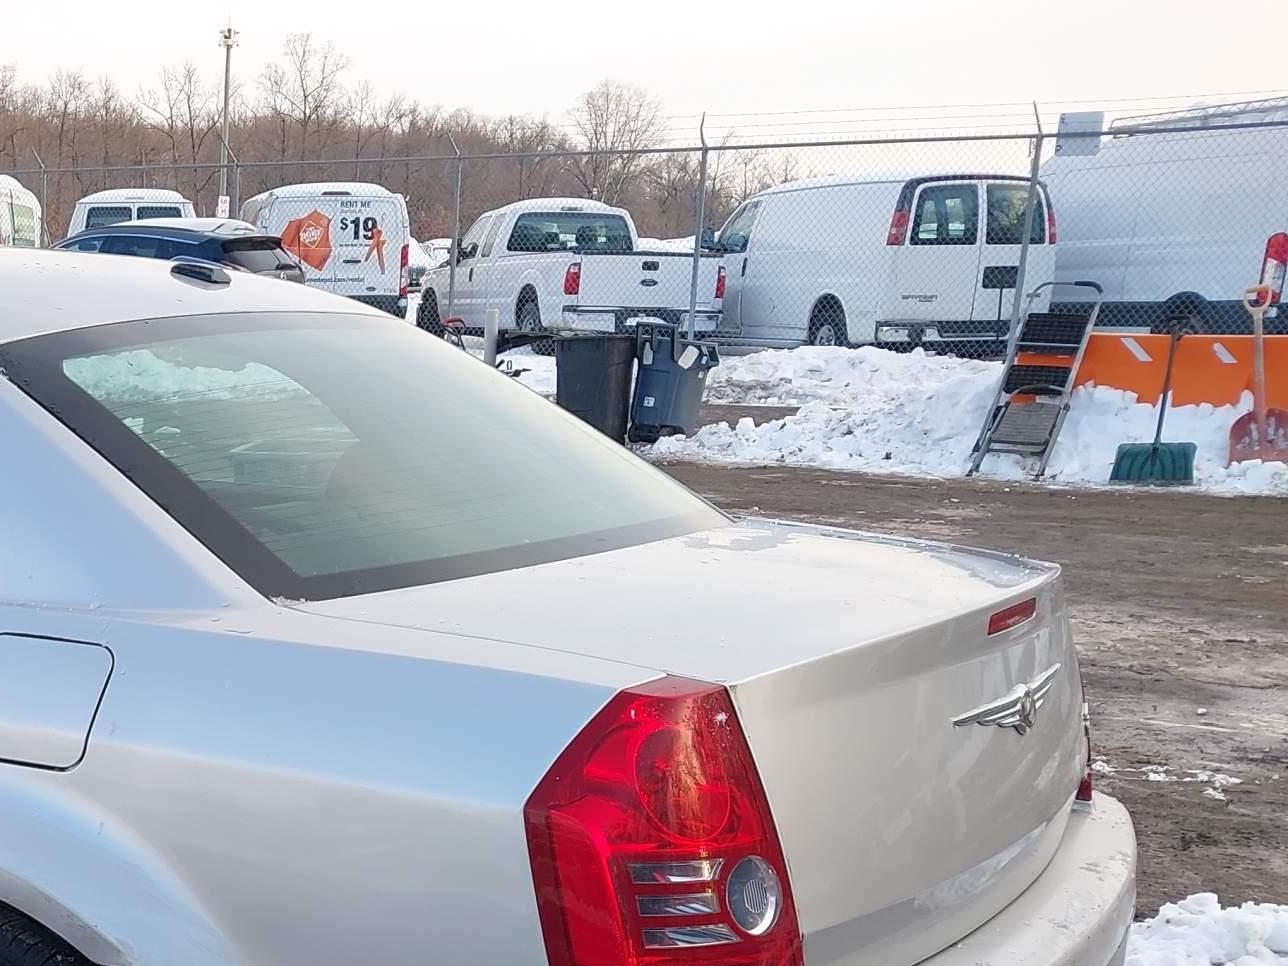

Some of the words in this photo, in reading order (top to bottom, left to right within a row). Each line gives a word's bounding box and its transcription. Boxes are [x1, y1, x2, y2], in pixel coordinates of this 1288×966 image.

[340, 200, 361, 209] RENT
[361, 200, 372, 209] ME
[339, 216, 378, 241] $19
